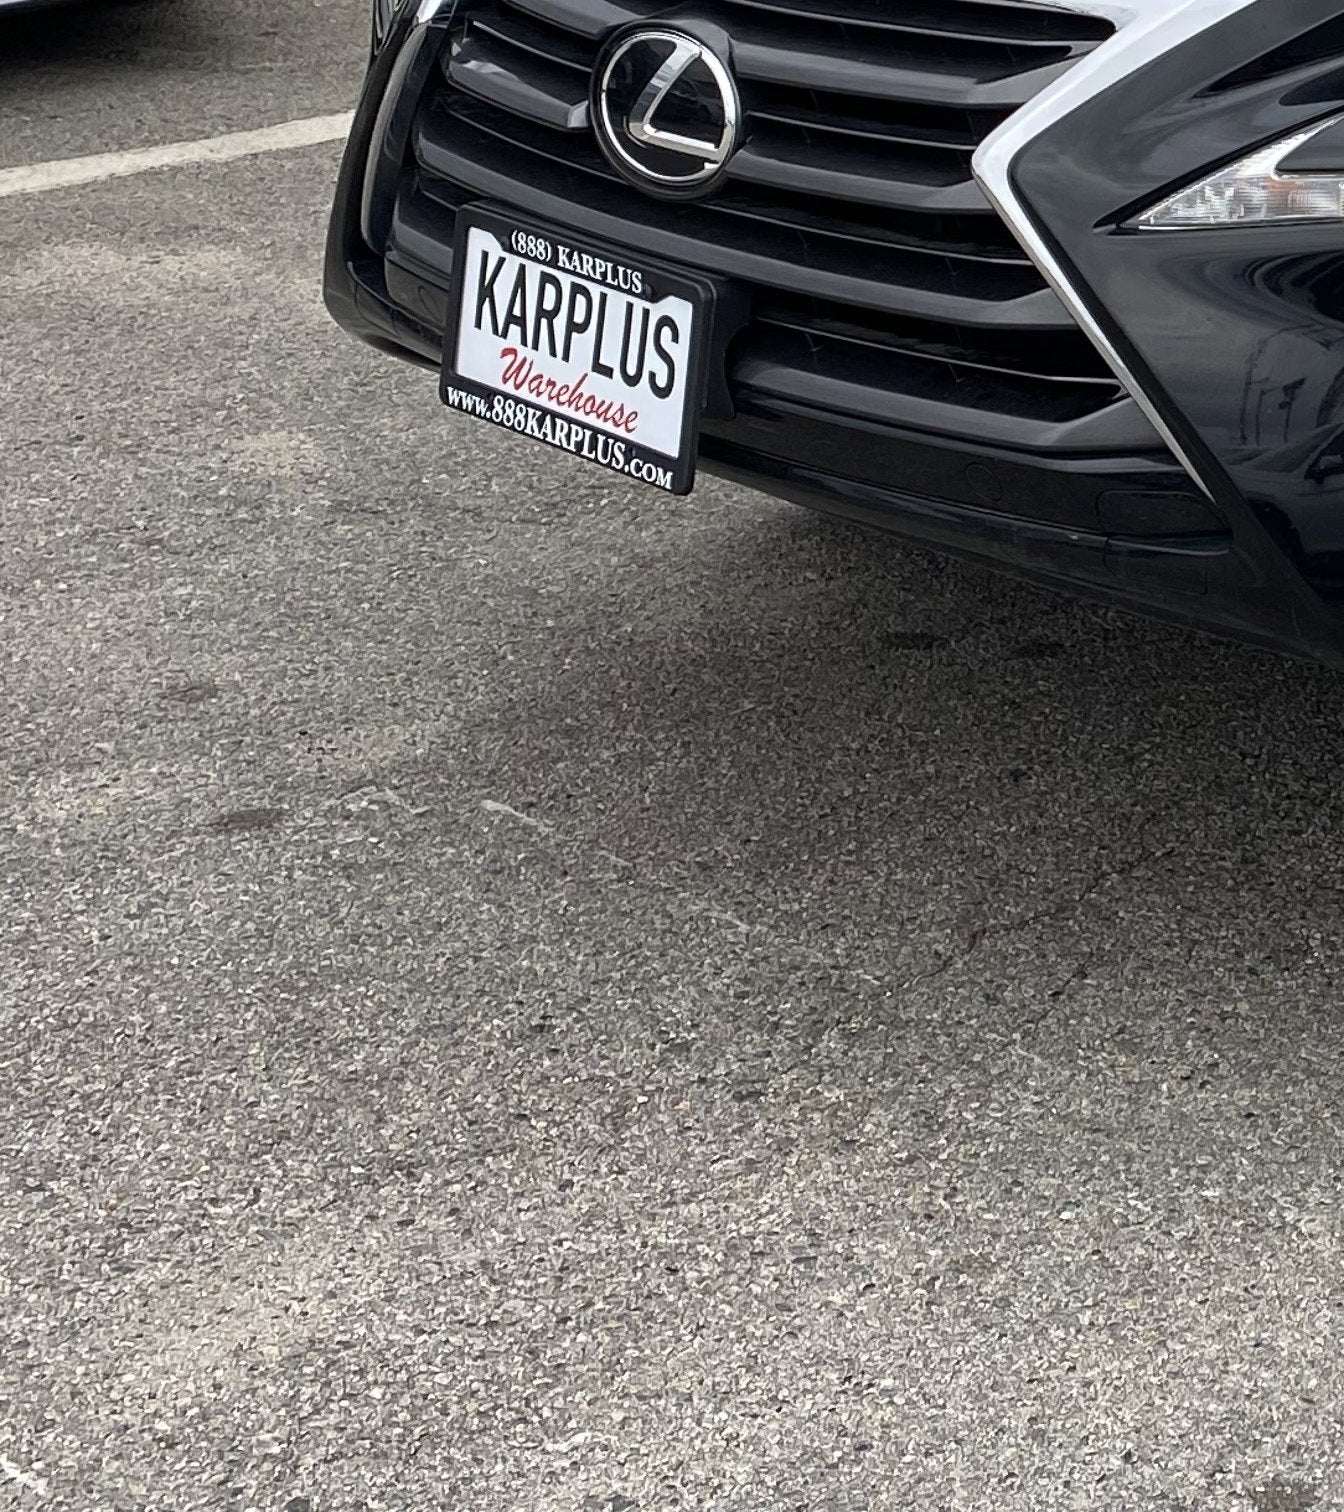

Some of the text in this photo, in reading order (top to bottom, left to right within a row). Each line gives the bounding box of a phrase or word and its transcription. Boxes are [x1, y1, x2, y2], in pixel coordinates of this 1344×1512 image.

[511, 229, 642, 294] (888) KARPLUS
[474, 249, 679, 400] KARPLUS
[499, 346, 639, 434] Warehouse
